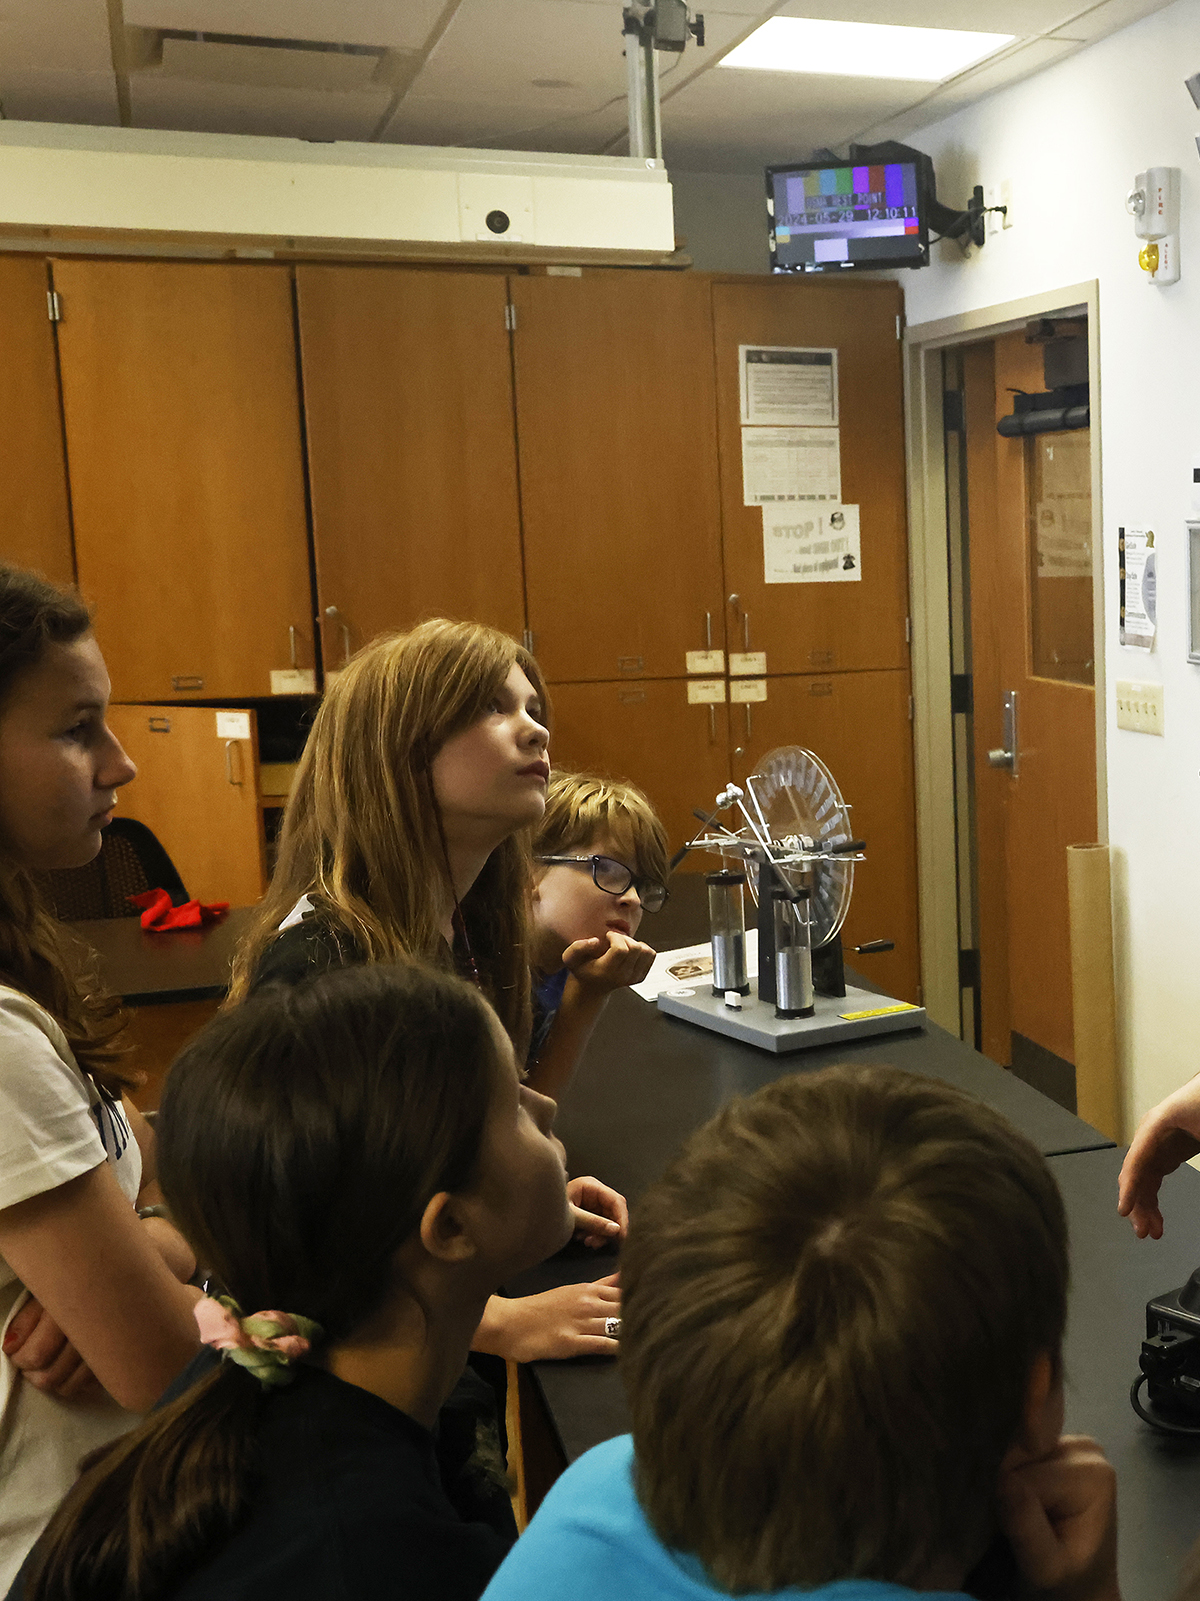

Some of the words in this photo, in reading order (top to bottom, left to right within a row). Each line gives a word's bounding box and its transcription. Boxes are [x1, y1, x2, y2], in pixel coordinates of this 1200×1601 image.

[857, 191, 882, 205] POINT
[777, 210, 854, 226] 2024-05-29
[866, 206, 916, 221] 12:10:11
[772, 520, 814, 539] STOP
